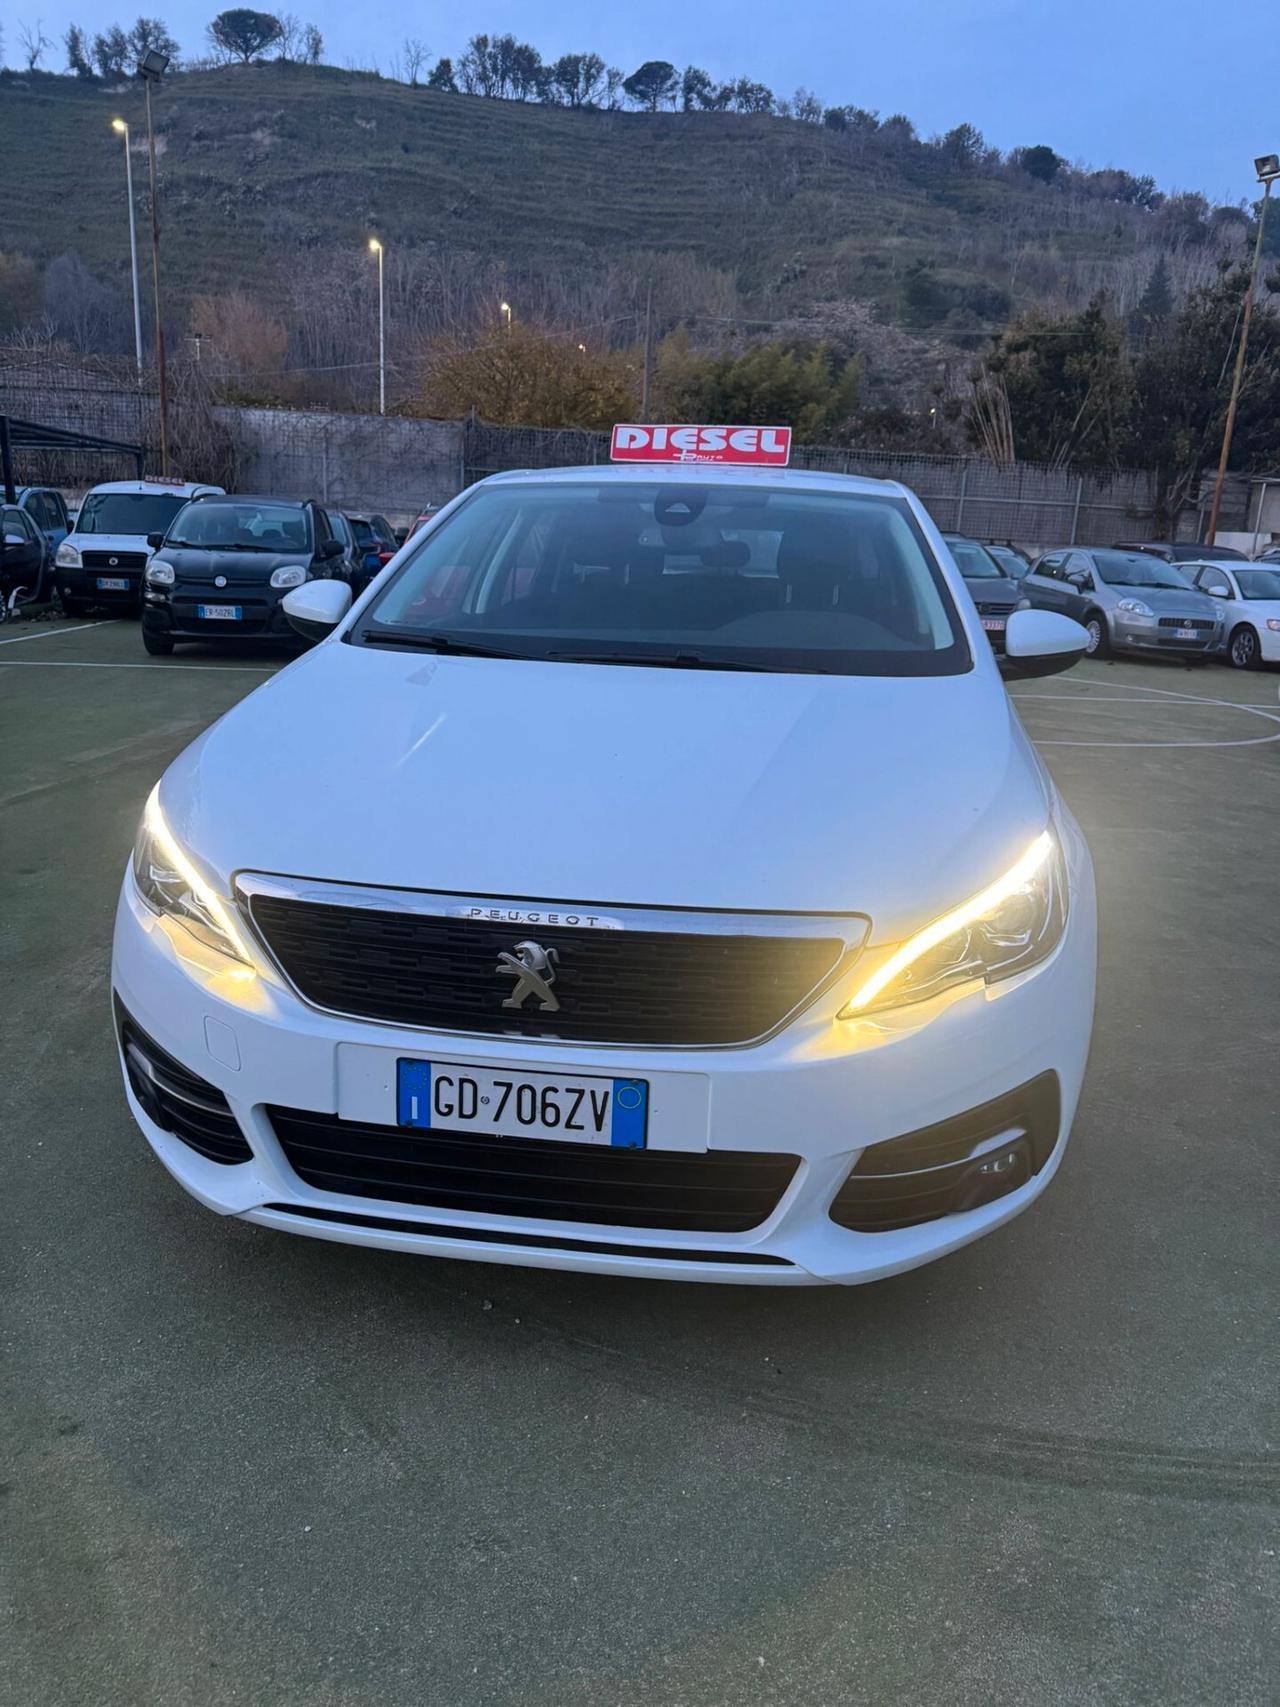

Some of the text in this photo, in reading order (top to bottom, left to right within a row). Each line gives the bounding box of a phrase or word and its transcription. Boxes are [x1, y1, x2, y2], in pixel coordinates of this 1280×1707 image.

[616, 427, 785, 453] DIESEL
[145, 475, 184, 485] DIESEL
[470, 908, 599, 927] PEUGEOT
